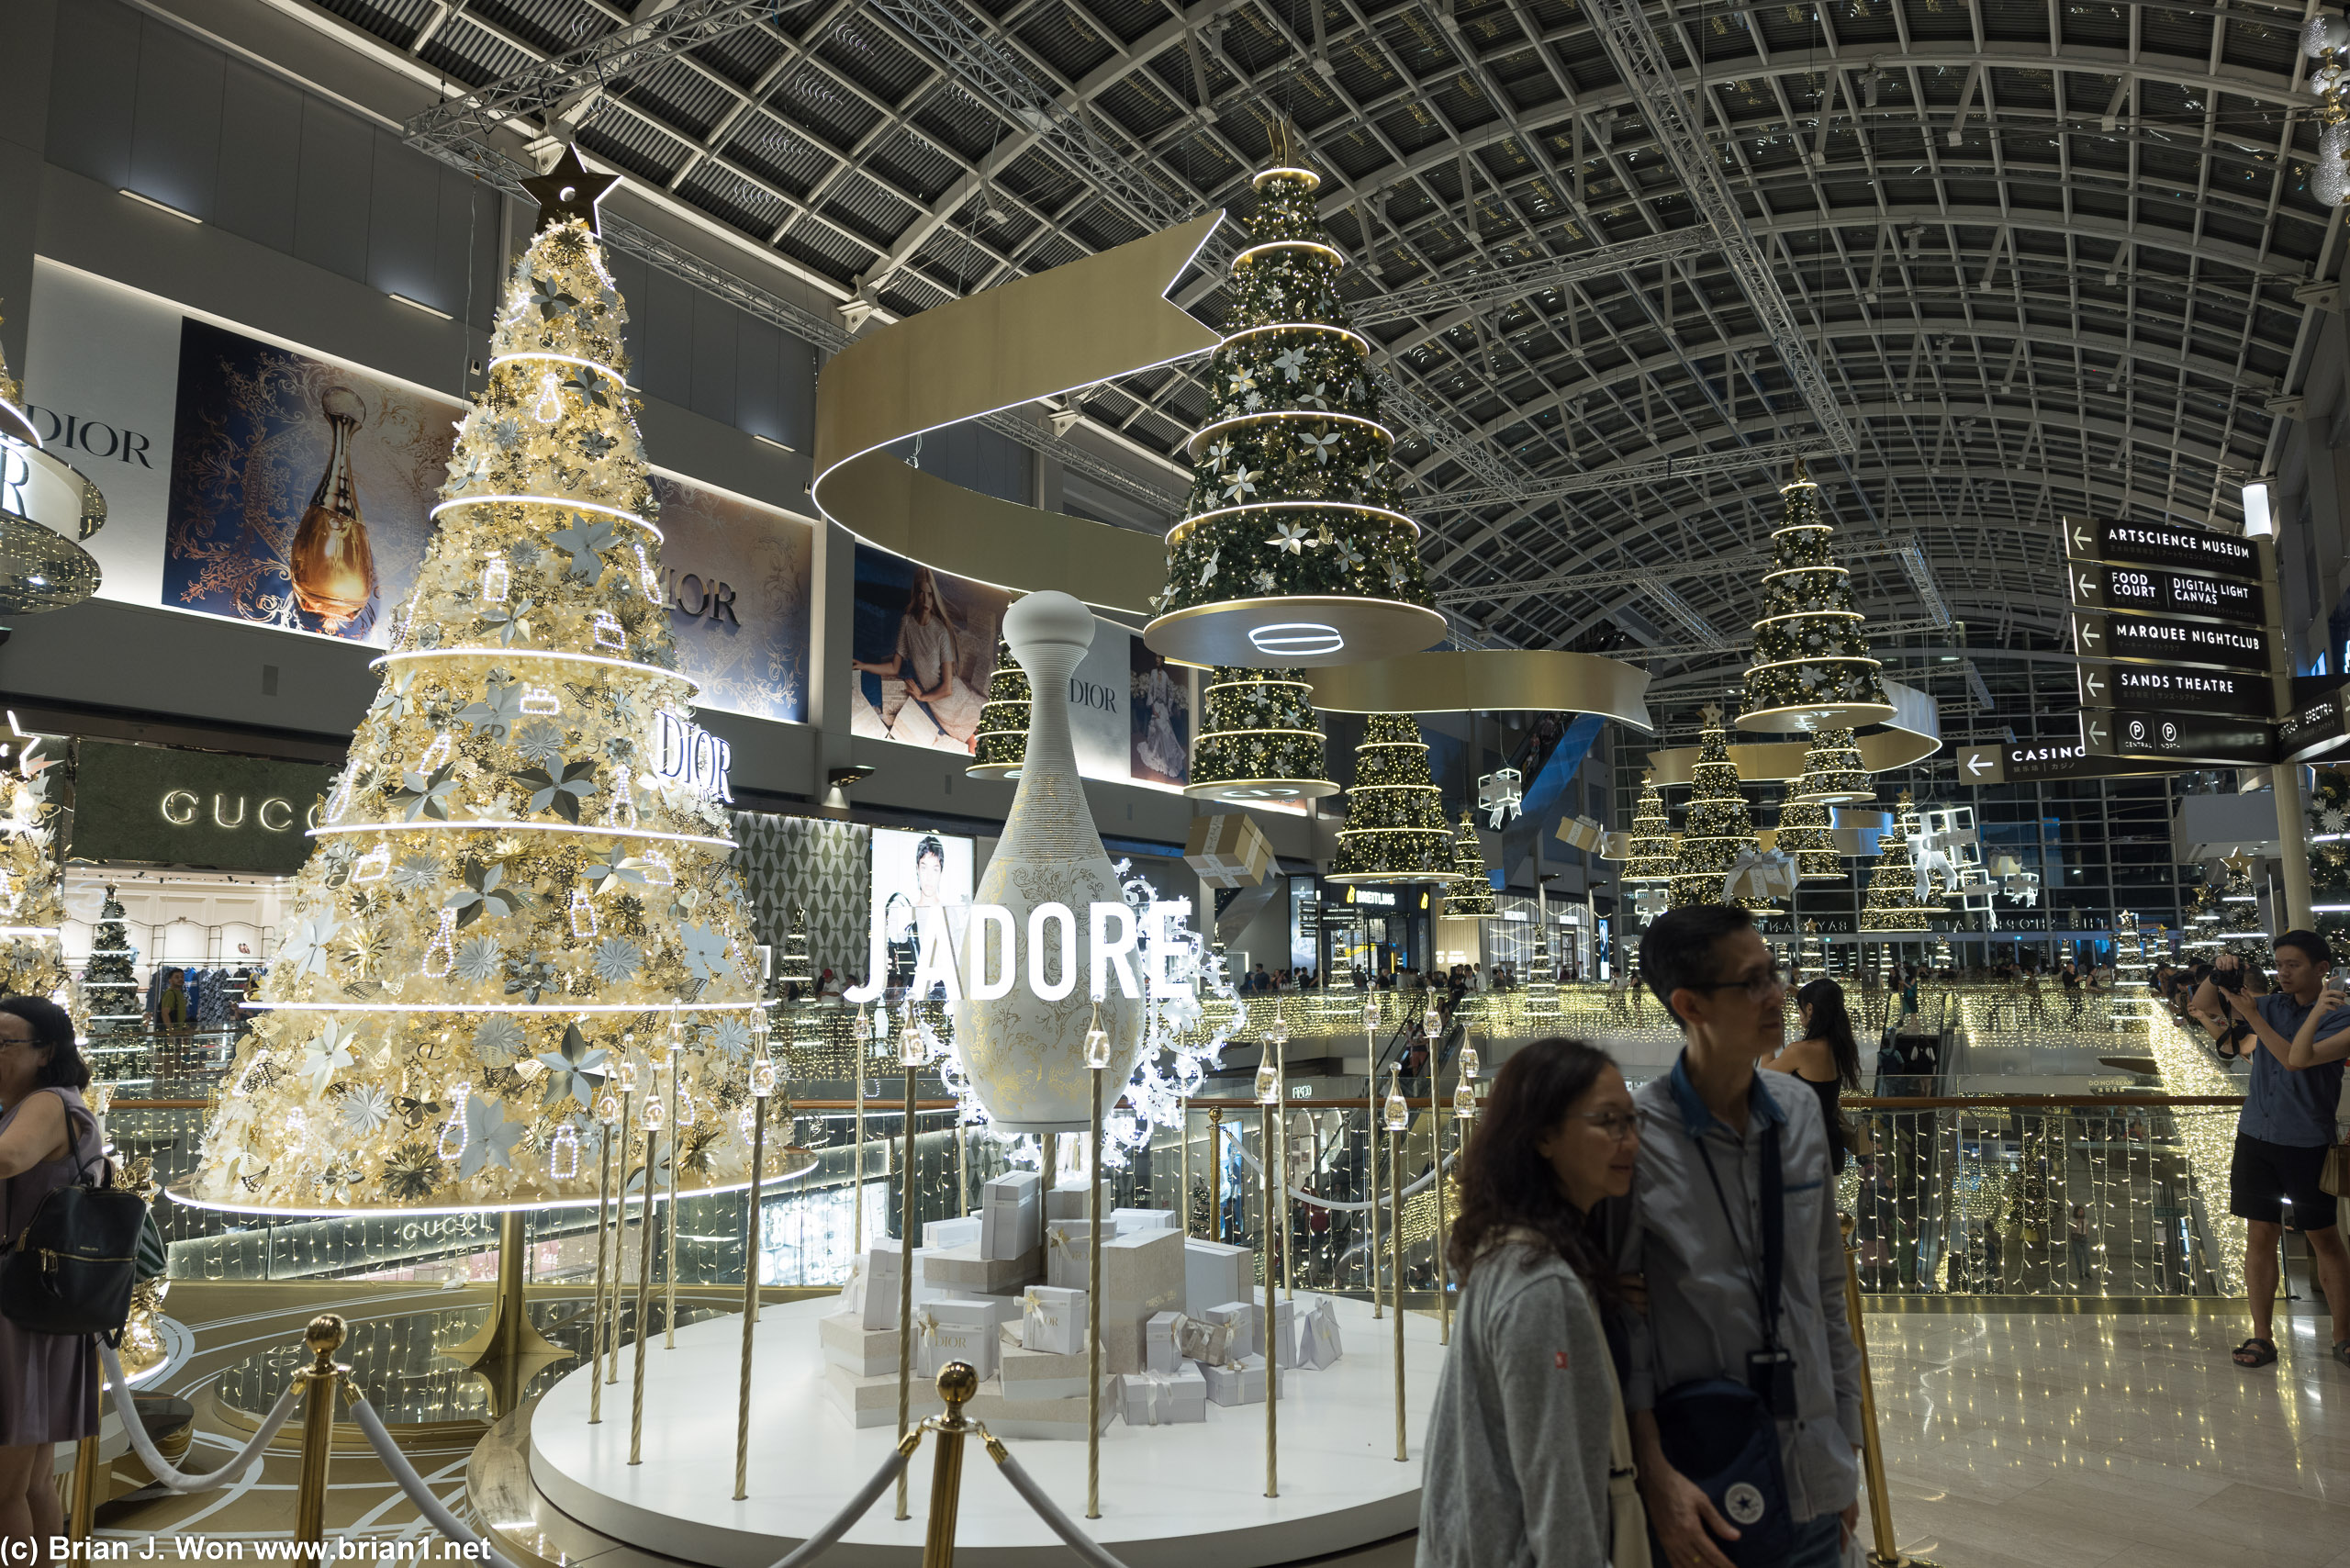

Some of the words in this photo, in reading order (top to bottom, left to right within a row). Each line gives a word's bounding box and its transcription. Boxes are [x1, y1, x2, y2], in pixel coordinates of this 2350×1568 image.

[25, 403, 153, 469] DIOR
[2109, 529, 2197, 549] ARTSCIENCE
[2202, 541, 2249, 558] MUSEUM
[2112, 572, 2148, 585] FOOD
[2173, 577, 2218, 594] DIGITAL
[2221, 584, 2249, 599] LIGHT
[658, 566, 741, 626] IOR
[2114, 584, 2156, 598] COURT
[2175, 590, 2218, 605] CANVAS
[2117, 624, 2186, 641] MARQUEE
[2192, 631, 2260, 650] NIGHTCLUB
[2121, 674, 2170, 688] SANDS
[2176, 677, 2234, 693] THEATRE
[1069, 678, 1117, 713] DIOR
[2305, 703, 2333, 724] SPECTRA
[658, 711, 734, 803] DIOR
[2011, 745, 2086, 762] CASINO
[2051, 762, 2076, 770] カジノ
[162, 790, 321, 831] GUC
[1356, 890, 1395, 906] BREITLING
[403, 1213, 487, 1241] GUCCI
[934, 1336, 967, 1349] DIOR
